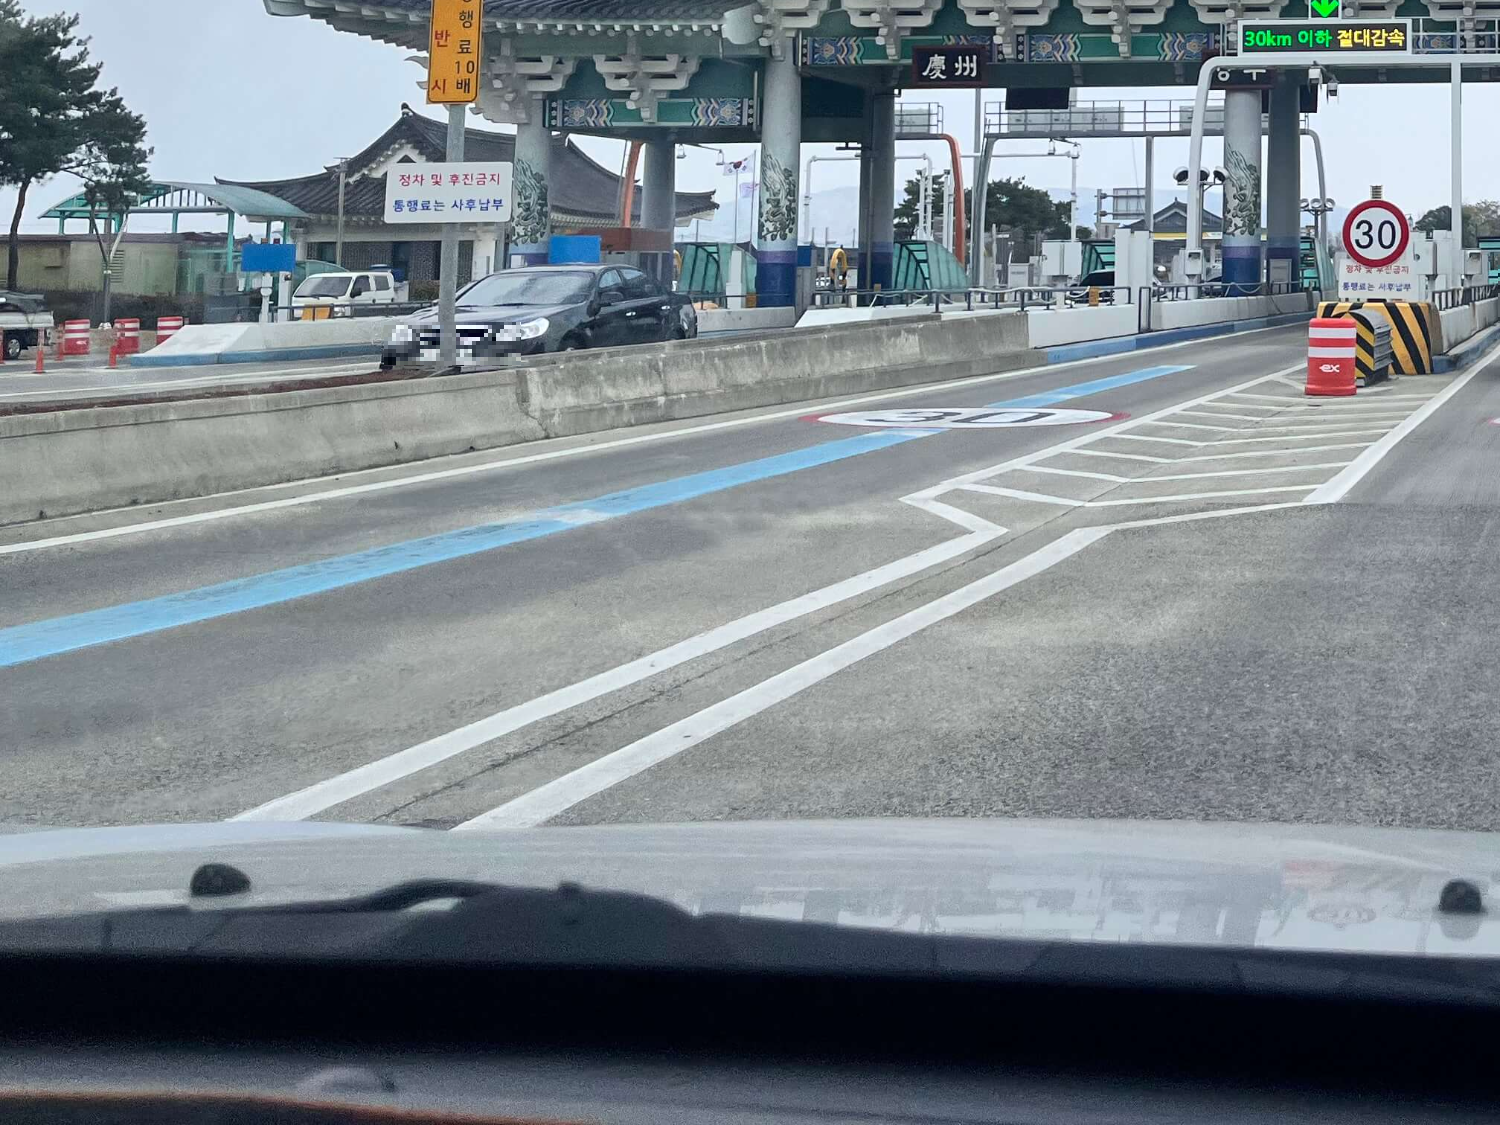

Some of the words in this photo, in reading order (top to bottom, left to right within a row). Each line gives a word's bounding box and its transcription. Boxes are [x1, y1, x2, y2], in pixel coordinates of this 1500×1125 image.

[1244, 29, 1292, 47] 30km
[1298, 29, 1333, 48] 이하
[1337, 28, 1405, 48] 절대감속
[922, 54, 977, 79] 慶州
[399, 173, 425, 187] 정차
[431, 174, 442, 186] 및
[448, 173, 500, 186] 후진금지
[393, 199, 445, 213] 통행료는
[451, 199, 504, 211] 사후납부
[1355, 219, 1396, 249] 30
[1319, 364, 1340, 373] ex
[866, 411, 1056, 424] 30
